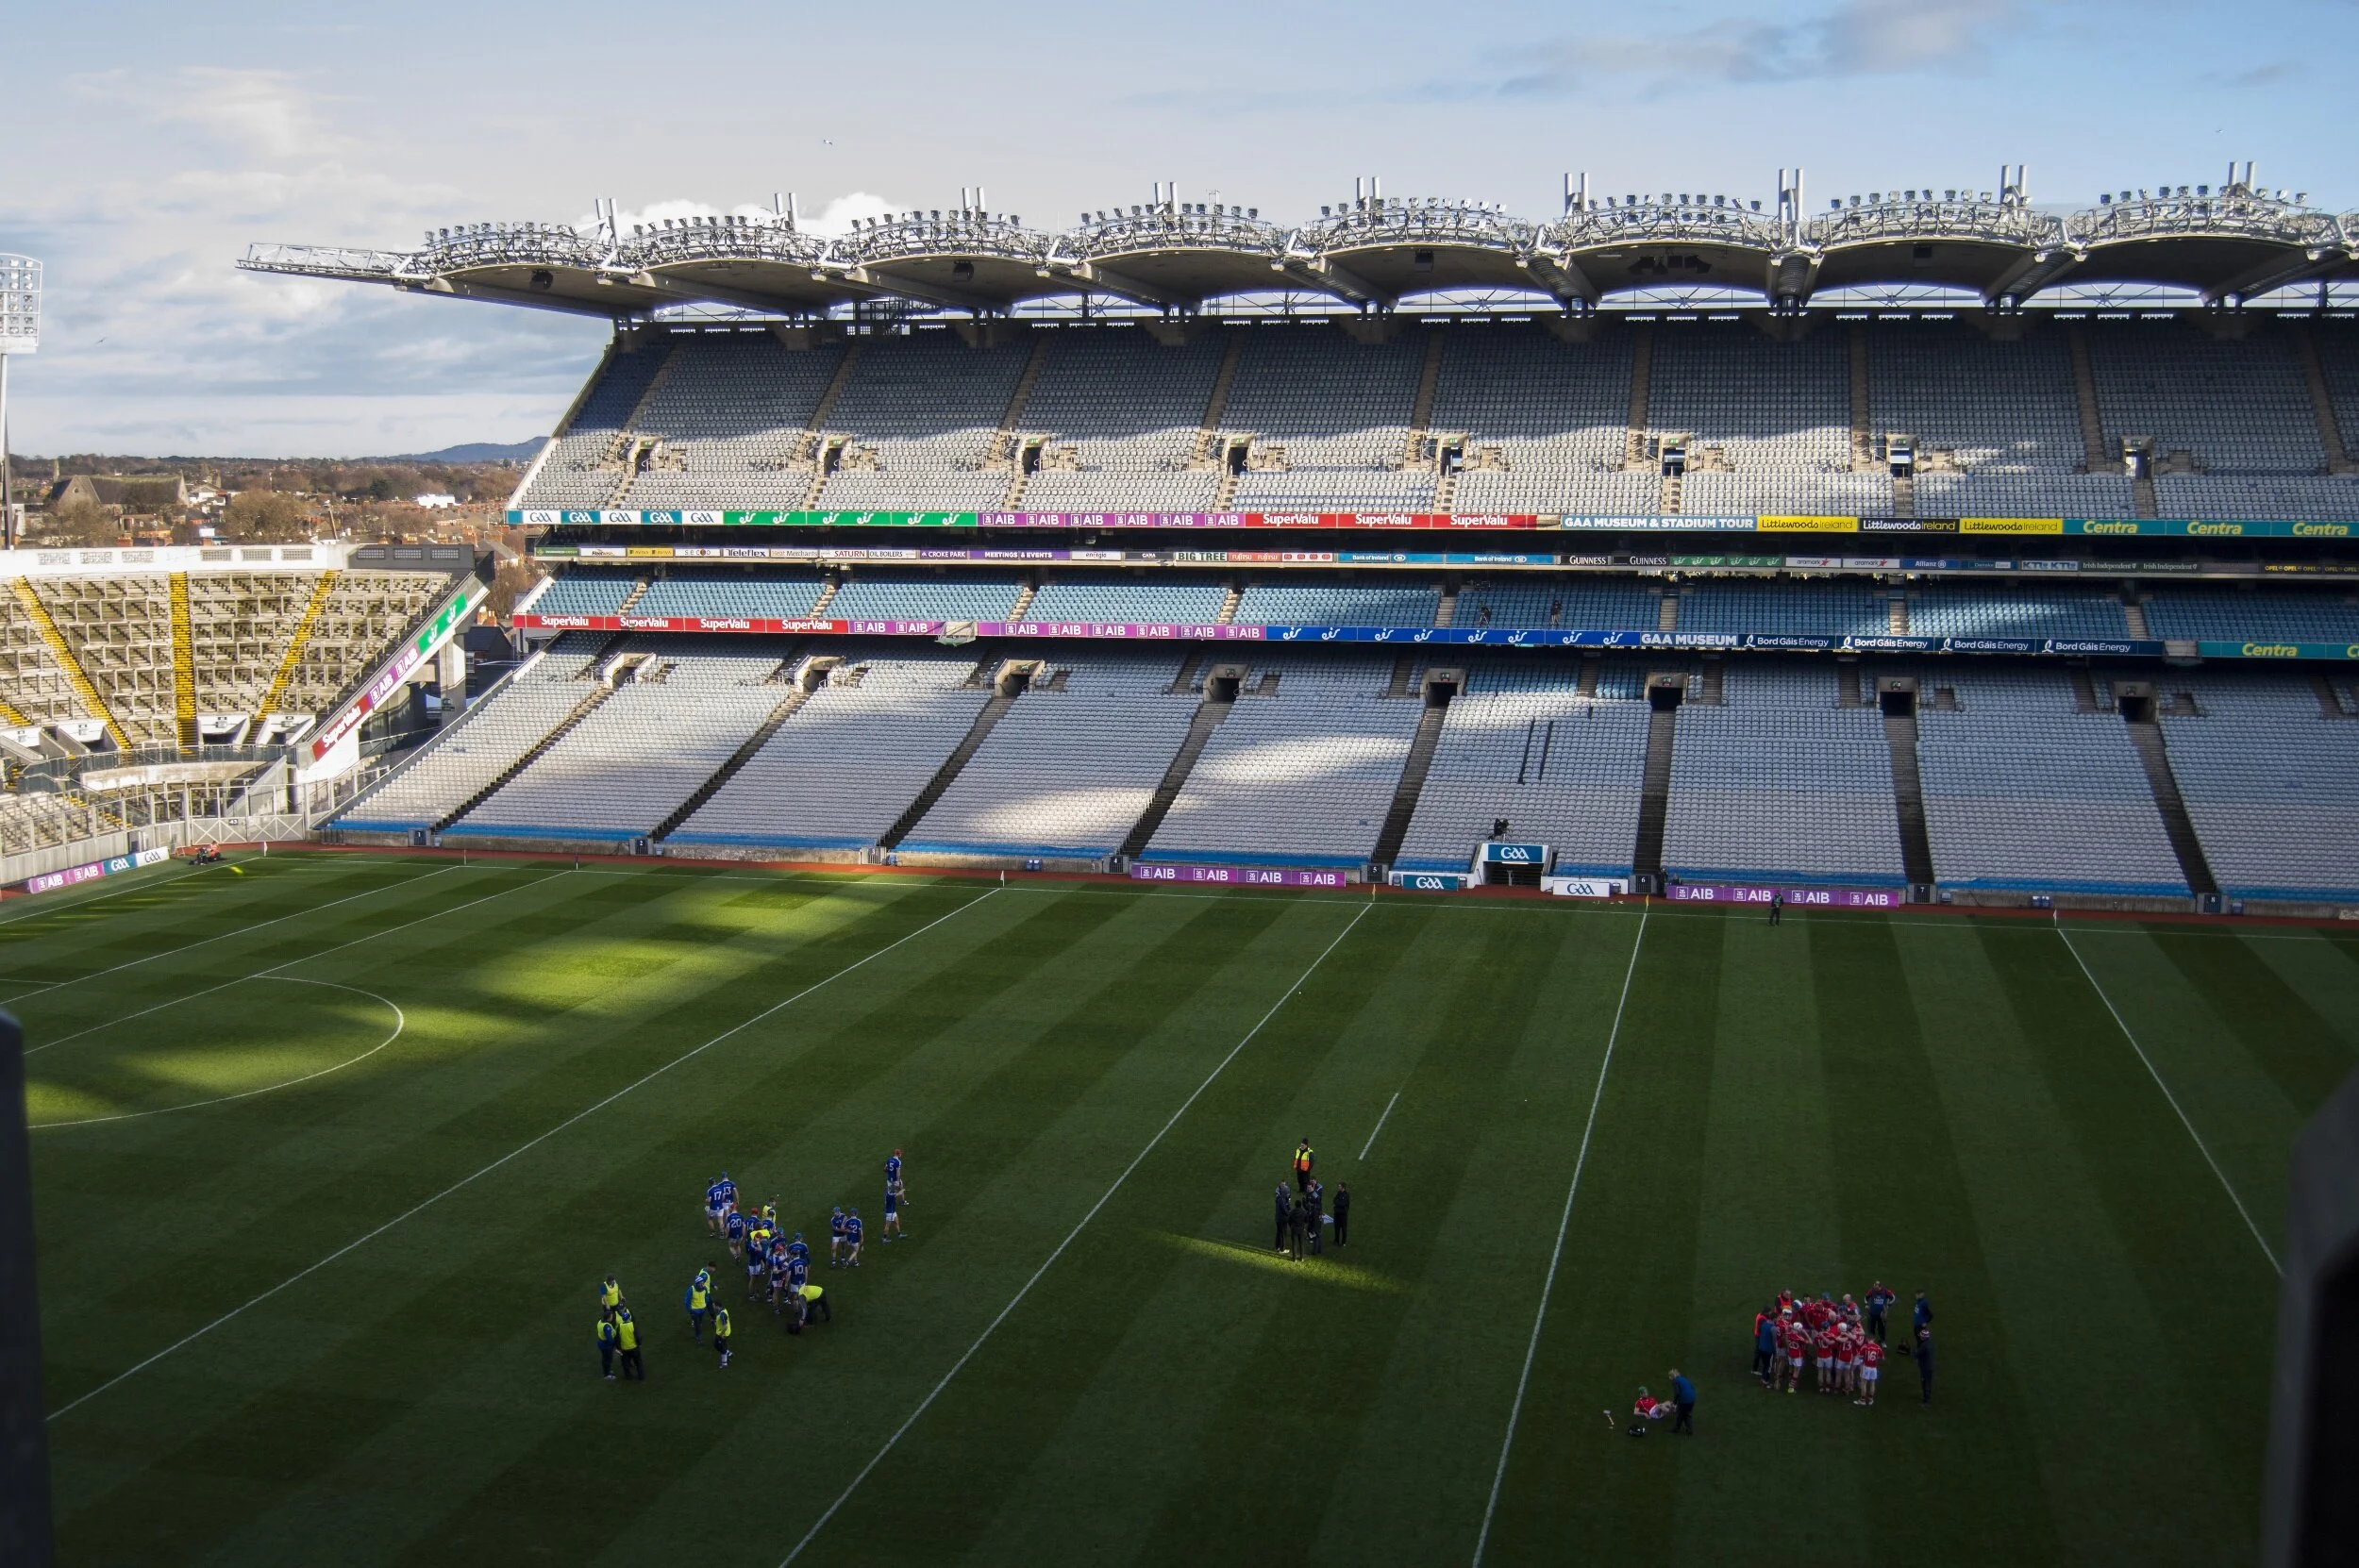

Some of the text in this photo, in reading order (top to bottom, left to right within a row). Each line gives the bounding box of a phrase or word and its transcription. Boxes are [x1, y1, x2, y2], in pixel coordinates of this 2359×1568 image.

[529, 512, 552, 523] GAA
[569, 512, 593, 523] GAA
[610, 512, 632, 523] GAA
[650, 512, 674, 523] GAA
[691, 512, 714, 523] GAA
[995, 515, 1014, 525] AIB
[1039, 515, 1059, 525] AIB
[1083, 514, 1103, 525] AIB
[1128, 515, 1147, 525] AIB
[1173, 515, 1193, 525] AIB
[1218, 515, 1238, 525] AIB
[1263, 514, 1318, 526] SuperValu
[1356, 514, 1412, 526] SuperValu
[1450, 515, 1508, 527] SuperValu
[1565, 518, 1753, 527] GAA MUSEUM & STADIUM TOUR
[2083, 521, 2137, 534] Centra
[2187, 523, 2242, 535] Centra
[2292, 523, 2348, 535] Centra
[1569, 556, 1606, 565] GUINNESS
[1630, 557, 1666, 565] GUINNESS
[542, 616, 589, 628] SuperValu
[620, 618, 668, 628] SuperValu
[700, 619, 750, 630] SuperValu
[782, 620, 832, 632] SuperValu
[866, 623, 885, 632] AIB
[909, 623, 928, 633] AIB
[1018, 625, 1038, 634] AIB
[1062, 626, 1081, 635] AIB
[1105, 626, 1126, 635] AIB
[1149, 626, 1169, 636] AIB
[1195, 627, 1214, 637] AIB
[1239, 628, 1260, 638] AIB
[1642, 634, 1737, 645] GAA MUSEUM
[1799, 639, 1829, 647] Energy
[1878, 639, 1896, 647] Gáis
[1898, 640, 1927, 648] Energy
[1980, 641, 1997, 649] Gáis
[2080, 642, 2098, 651] Gáis
[2100, 643, 2131, 652] Energy
[2242, 643, 2297, 657] Centra
[379, 675, 393, 694] AIB
[323, 706, 360, 747] SuperValu
[1500, 847, 1530, 859] GAA
[84, 866, 98, 877] AIB
[1154, 868, 1175, 879] AIB
[1207, 870, 1228, 881] AIB
[1260, 872, 1281, 882] AIB
[48, 875, 63, 886] AIB
[1313, 874, 1336, 884] AIB
[1416, 877, 1444, 890] GAA
[1567, 883, 1595, 895] GAA
[1691, 890, 1714, 900] AIB
[1748, 890, 1771, 901] AIB
[1806, 892, 1830, 903] AIB
[1865, 894, 1888, 905] AIB
[713, 1191, 722, 1201] 17
[729, 1218, 742, 1228] 20
[795, 1264, 804, 1276] 10
